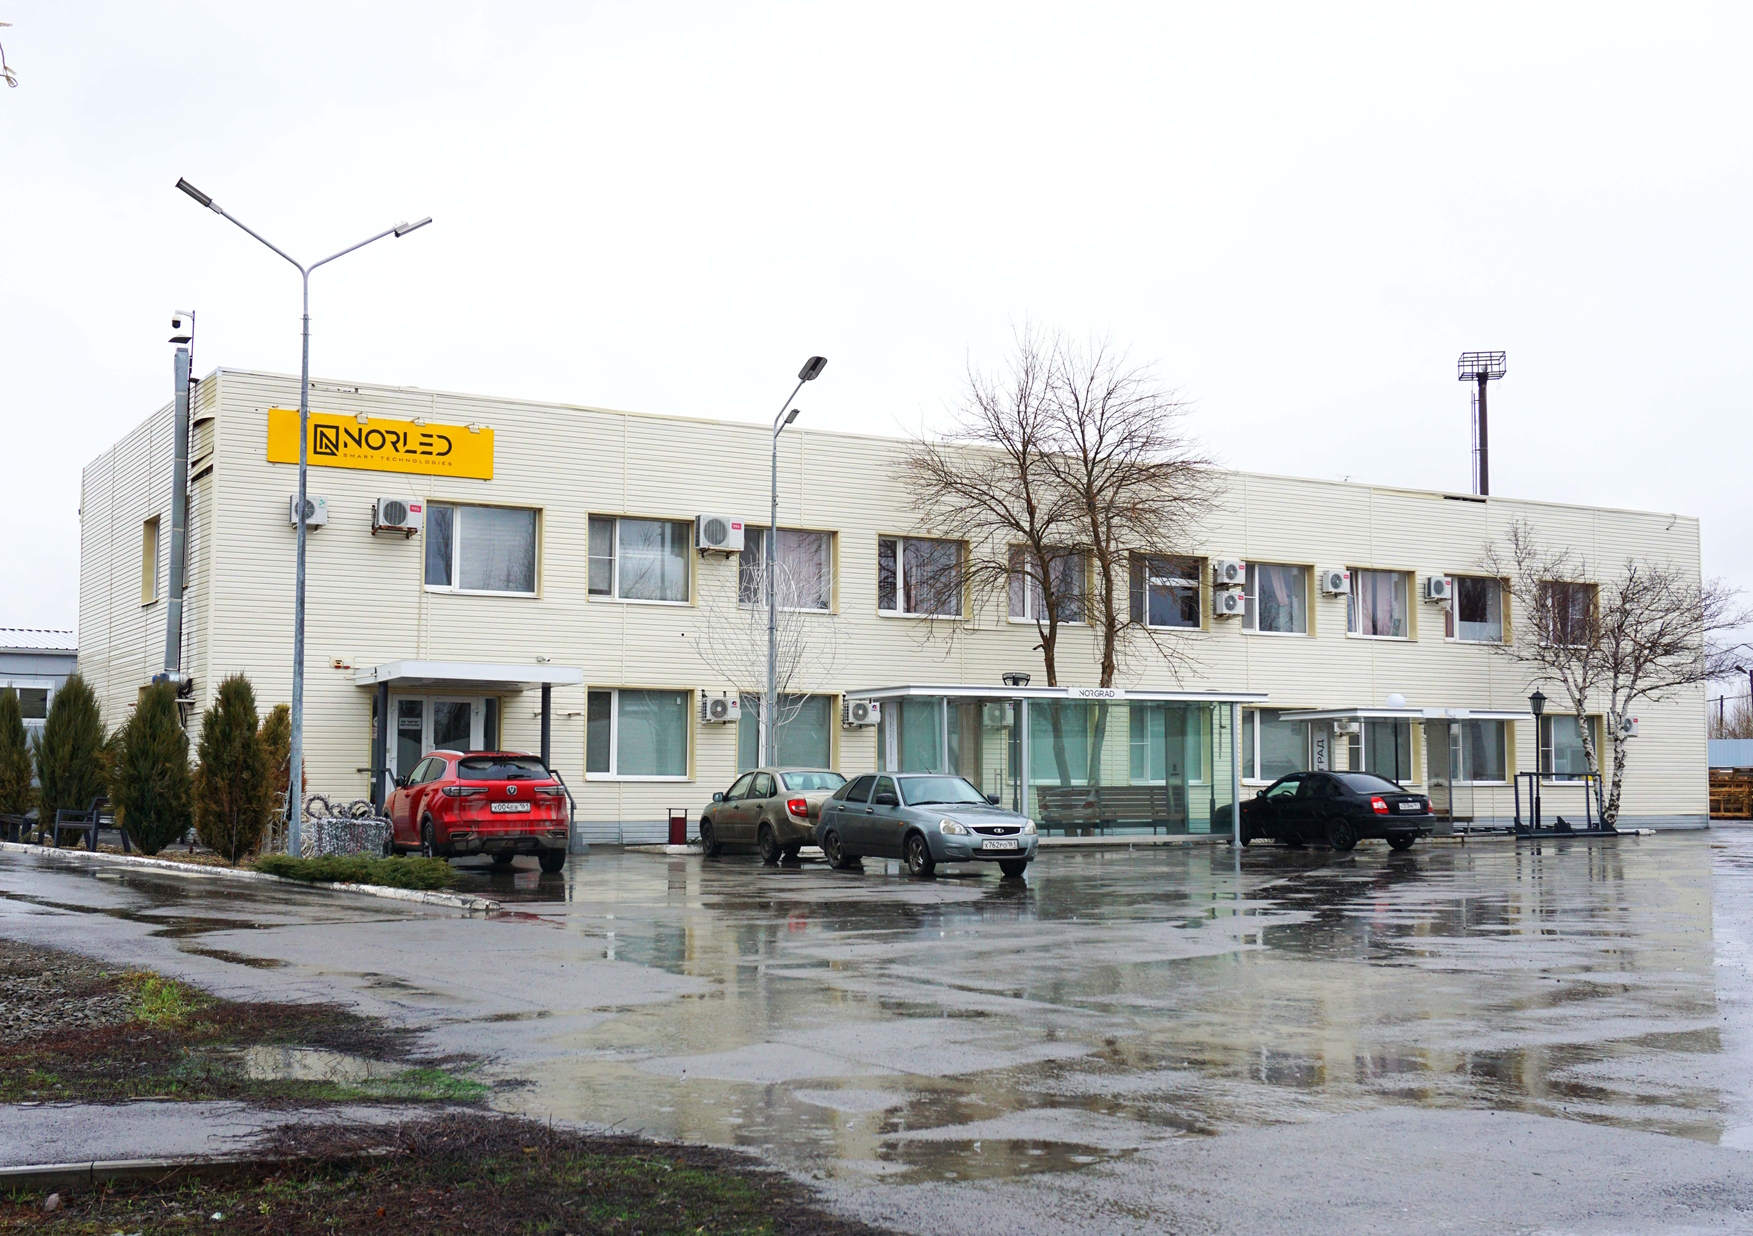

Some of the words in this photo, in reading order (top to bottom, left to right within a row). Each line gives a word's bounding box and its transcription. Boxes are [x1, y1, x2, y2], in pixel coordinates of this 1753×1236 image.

[343, 426, 453, 457] NORLED
[380, 456, 453, 466] TECHNOLOGIES
[1079, 689, 1115, 697] NORGRAD
